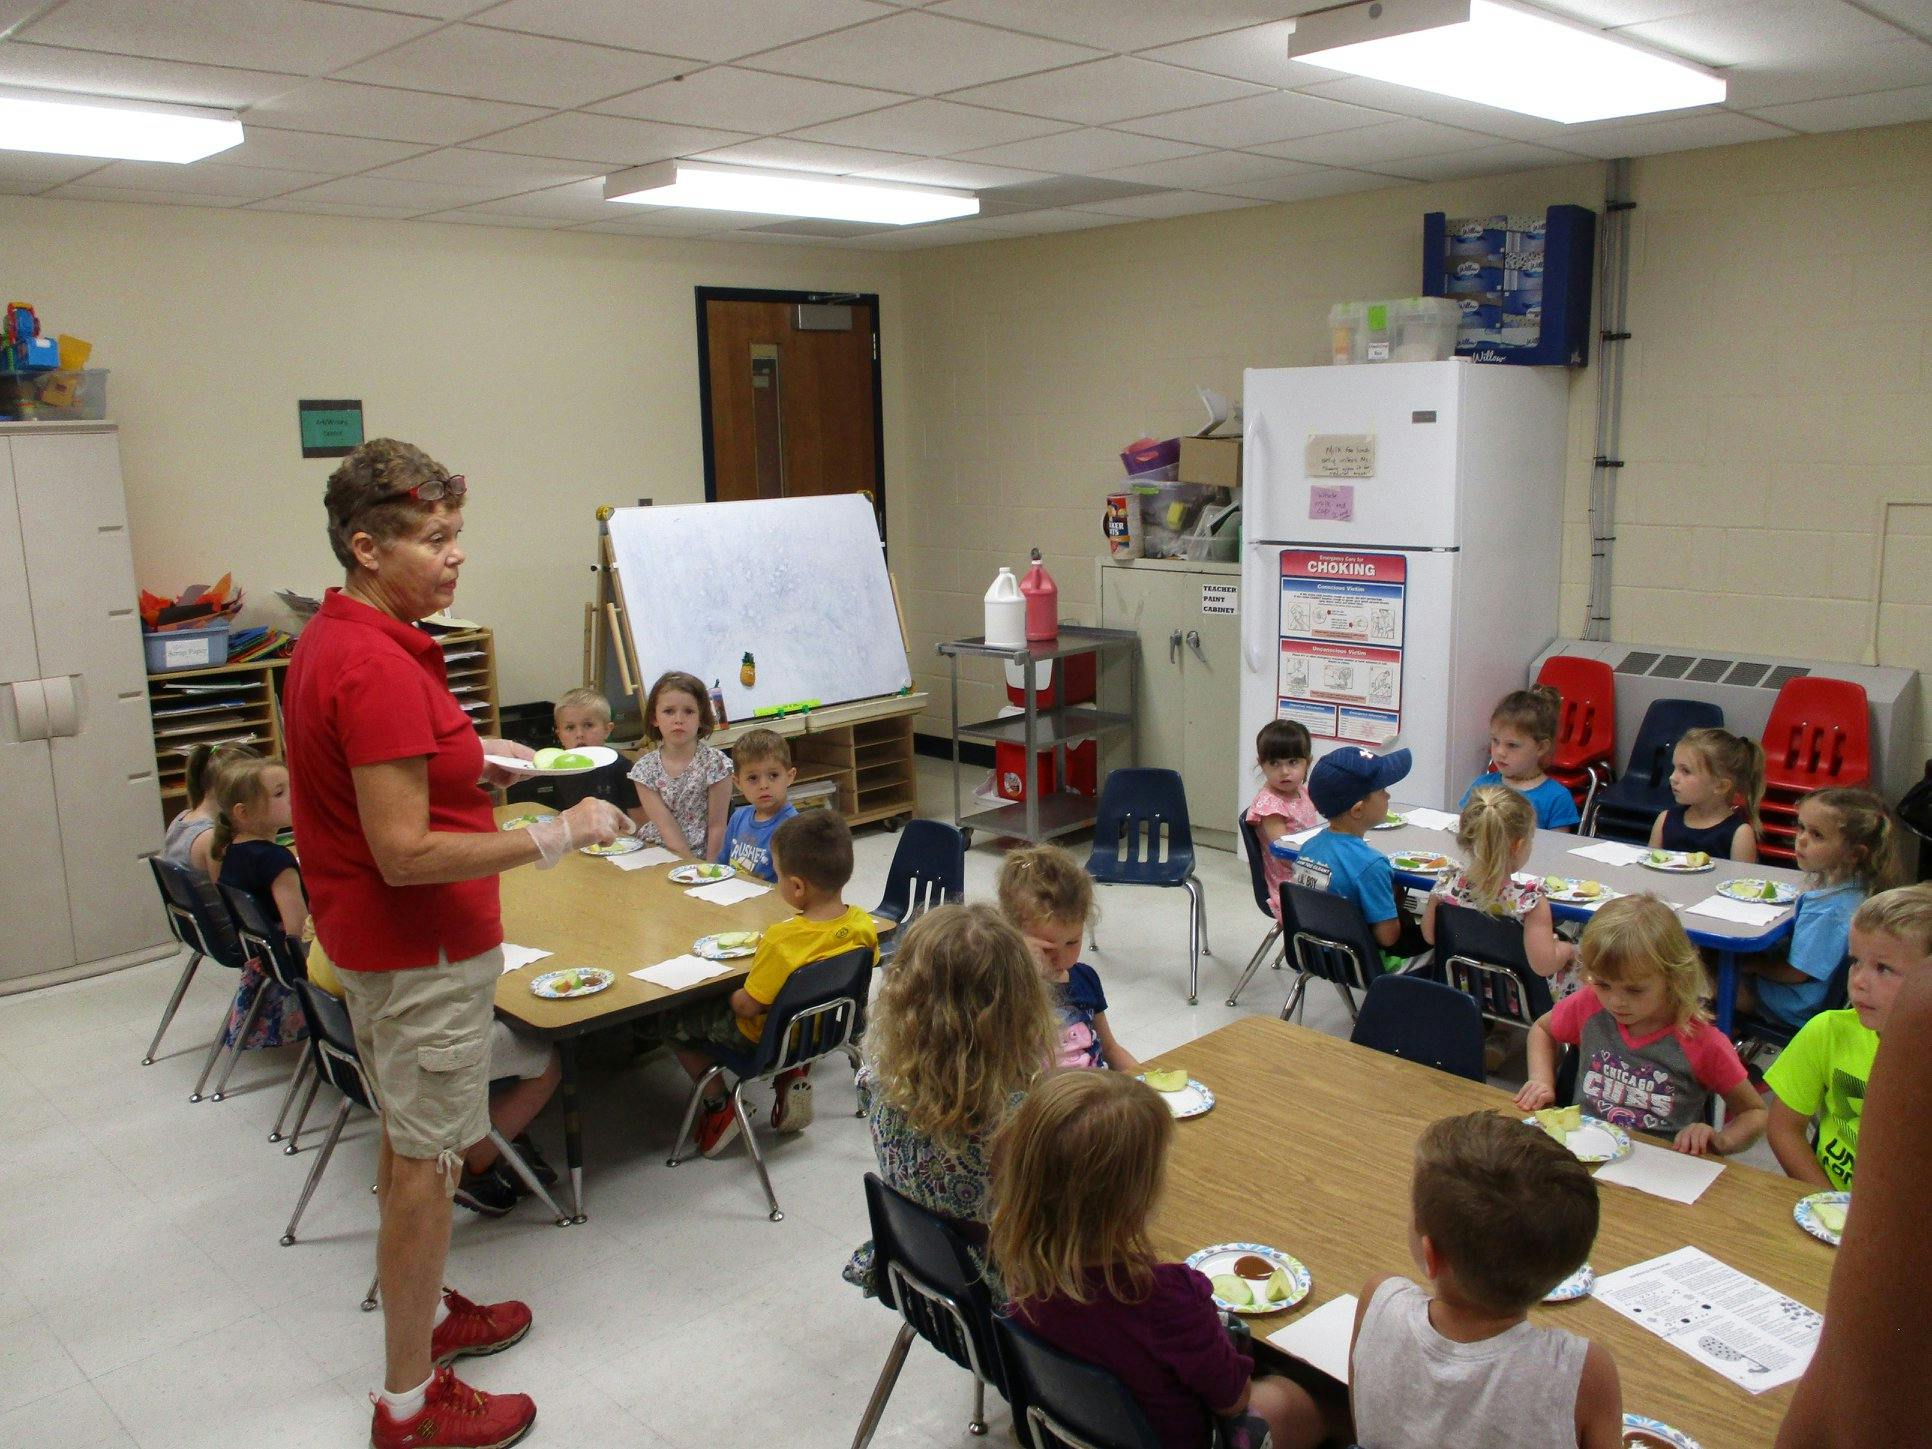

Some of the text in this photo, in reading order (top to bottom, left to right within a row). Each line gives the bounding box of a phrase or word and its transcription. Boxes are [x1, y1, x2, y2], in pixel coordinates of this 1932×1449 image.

[1459, 265, 1479, 274] Willow
[1458, 301, 1478, 311] Willow
[1456, 338, 1475, 347] Willow
[1472, 350, 1507, 363] Willow
[1307, 560, 1377, 577] CHOKING
[1203, 585, 1237, 593] TEACHER
[1317, 583, 1345, 591] Conscious
[1312, 645, 1367, 656] Unconscious Victim
[1603, 1064, 1655, 1092] CHICAGO
[1583, 1070, 1676, 1117] CUBS
